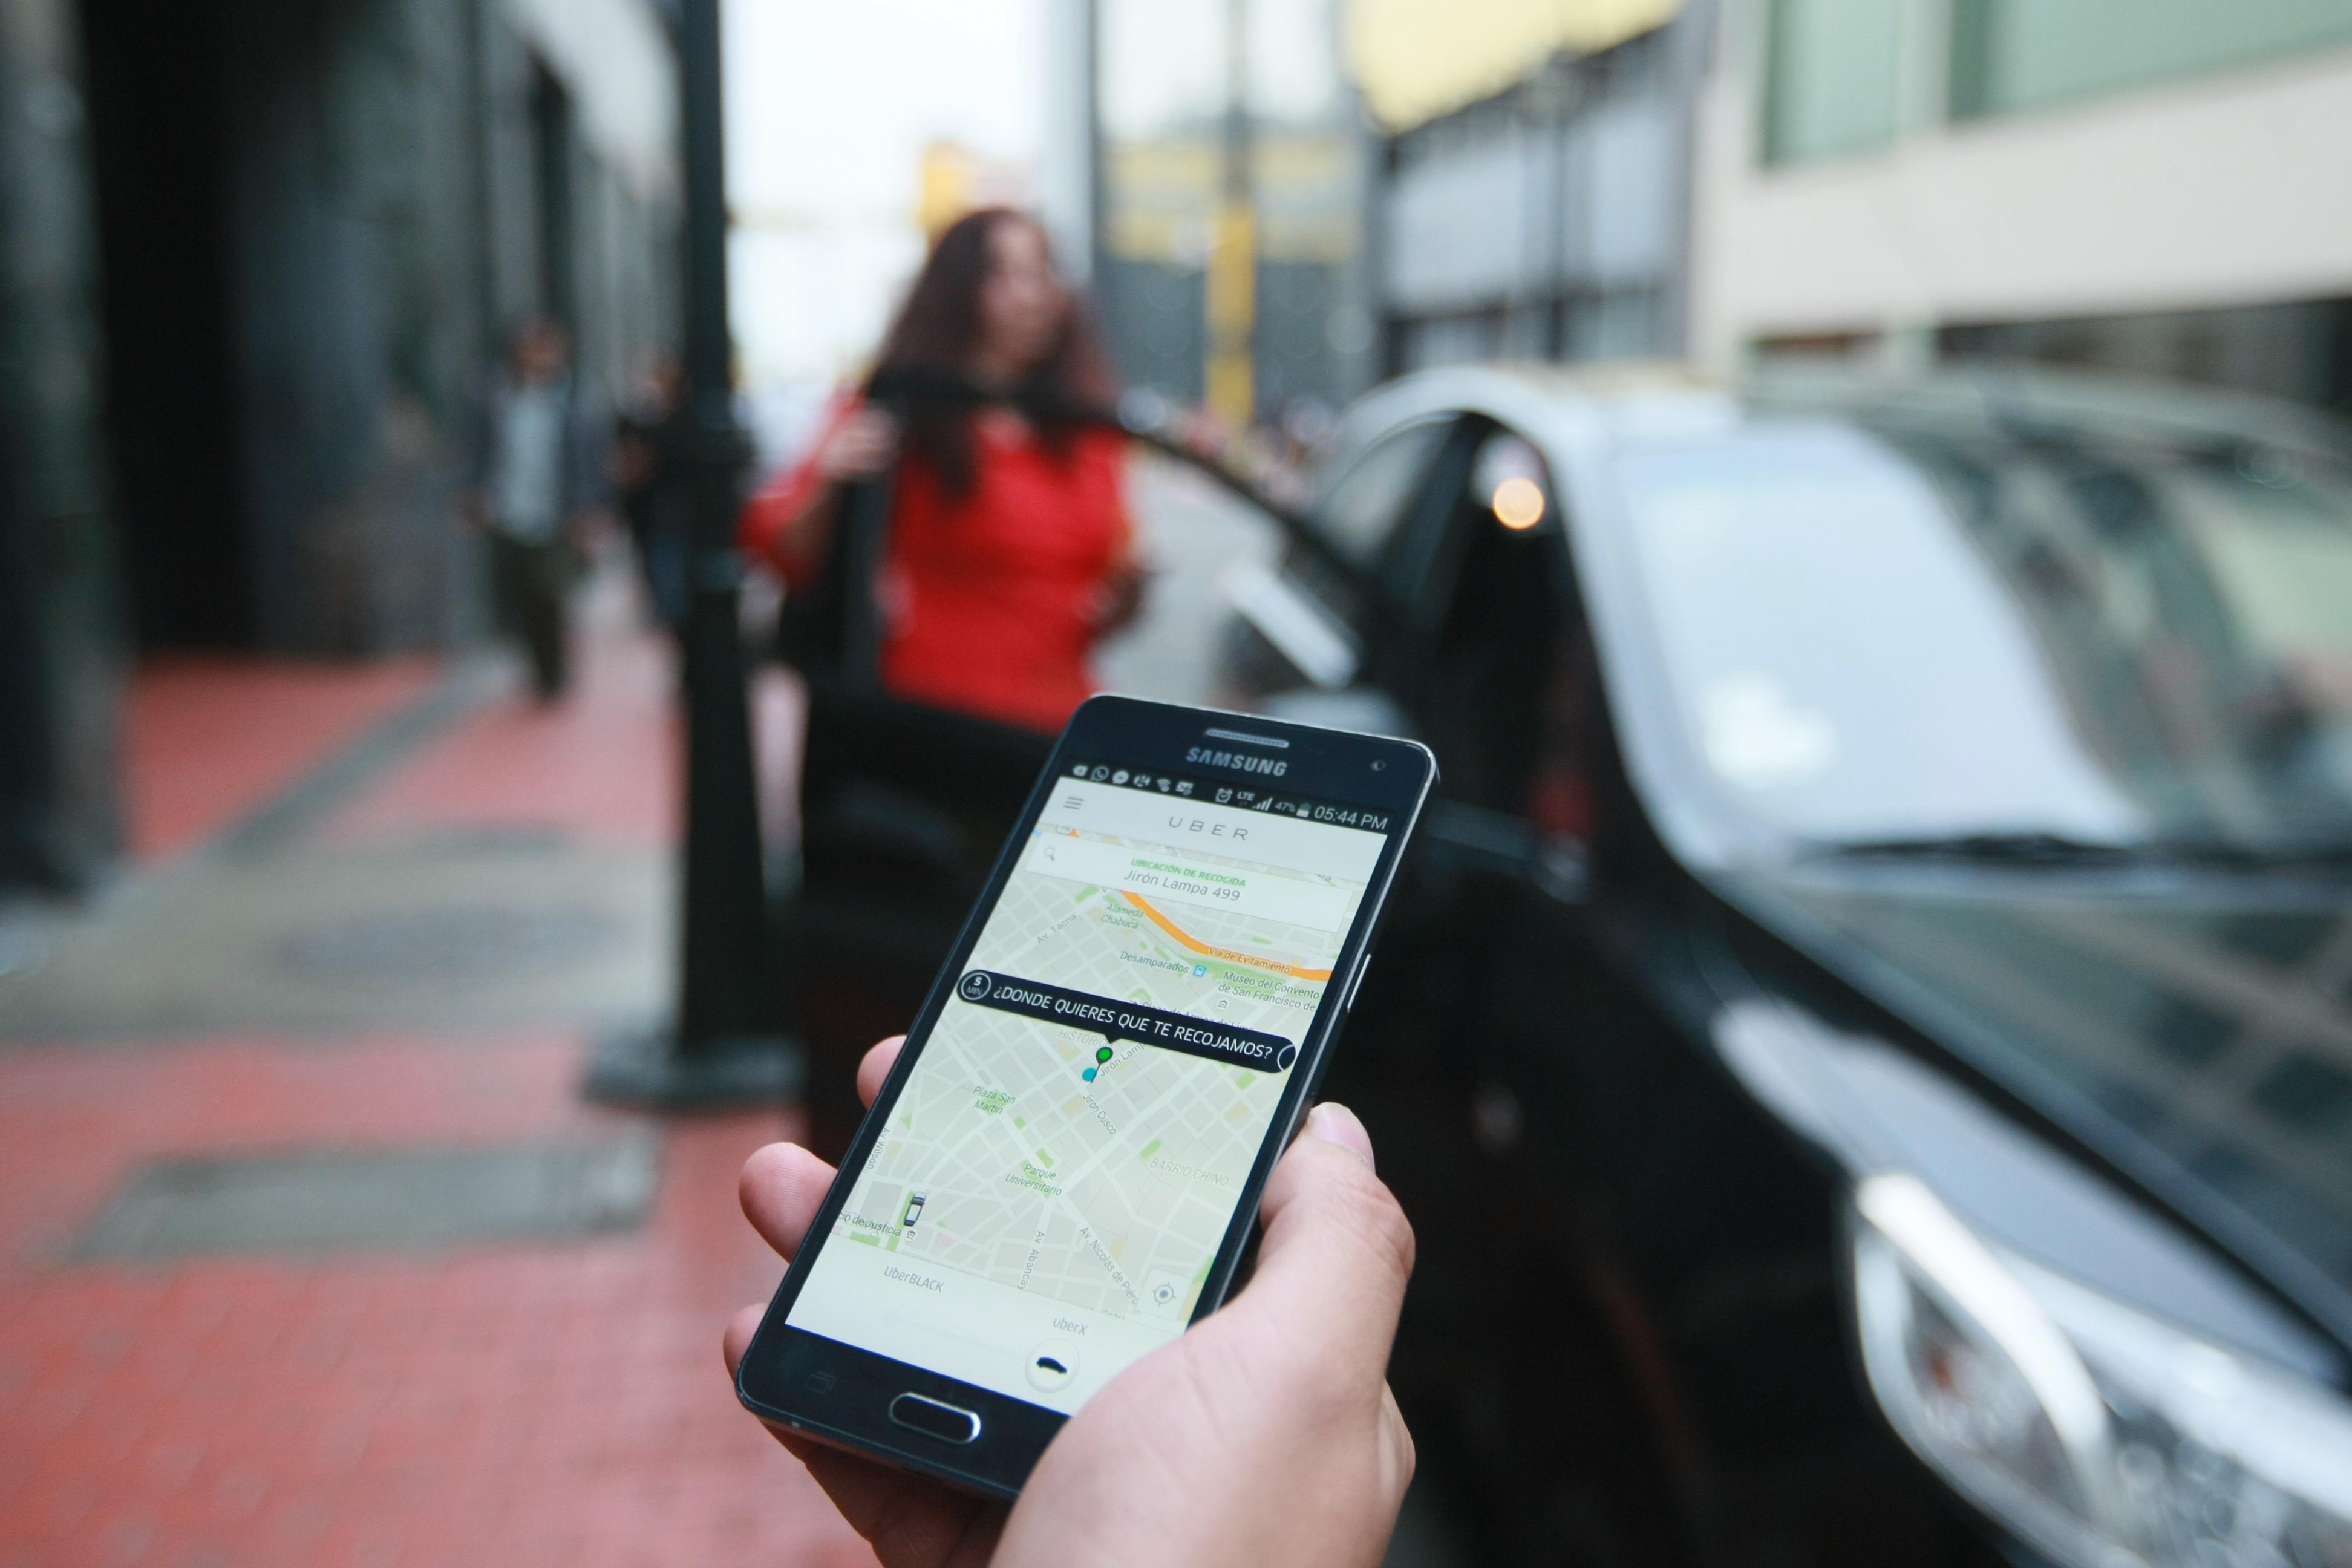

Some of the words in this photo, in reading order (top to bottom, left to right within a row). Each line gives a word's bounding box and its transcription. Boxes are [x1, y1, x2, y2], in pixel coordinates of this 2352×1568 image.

[1186, 746, 1288, 776] SAMSUNG
[1238, 792, 1255, 801] LTE
[1275, 802, 1295, 813] 47%
[1169, 816, 1249, 841] UBER
[1314, 807, 1357, 824] 05:44
[1361, 815, 1388, 830] PM
[1131, 858, 1181, 874] UBICACIÓN
[1184, 868, 1196, 877] DE
[1199, 872, 1246, 887] RECOGIDA
[1124, 870, 1158, 886] Jirón
[1162, 878, 1208, 895] Lampa
[1212, 888, 1240, 901] 499
[1101, 915, 1138, 929] Chabuca
[1105, 904, 1144, 918] Alameda
[1051, 915, 1077, 932] Tacna
[1120, 951, 1189, 973] Desamparados
[1224, 952, 1235, 960] de
[1238, 954, 1290, 973] Evitamiento
[1224, 971, 1255, 986] Museo
[1258, 979, 1272, 989] del
[1275, 982, 1319, 999] Convento
[1218, 983, 1230, 993] de
[1233, 987, 1251, 998] San
[1253, 991, 1301, 1008] Francisco
[1304, 1002, 1316, 1011] de
[993, 987, 1053, 1009] ¿DONDE
[1054, 999, 1116, 1024] QUIERES
[1119, 1014, 1151, 1031] QUE
[1154, 1021, 1172, 1036] TE
[1174, 1027, 1272, 1059] RECOJAMOS?
[1121, 1043, 1145, 1060] Lamp
[973, 1086, 997, 1099] Plaza
[999, 1093, 1016, 1103] San
[1024, 1164, 1056, 1180] Parque
[1150, 1158, 1192, 1177] BARRIO
[1194, 1169, 1229, 1186] CHINO
[1005, 1173, 1062, 1196] Universitario
[884, 1266, 946, 1293] UberBLACK
[1054, 1318, 1088, 1336] uberX
